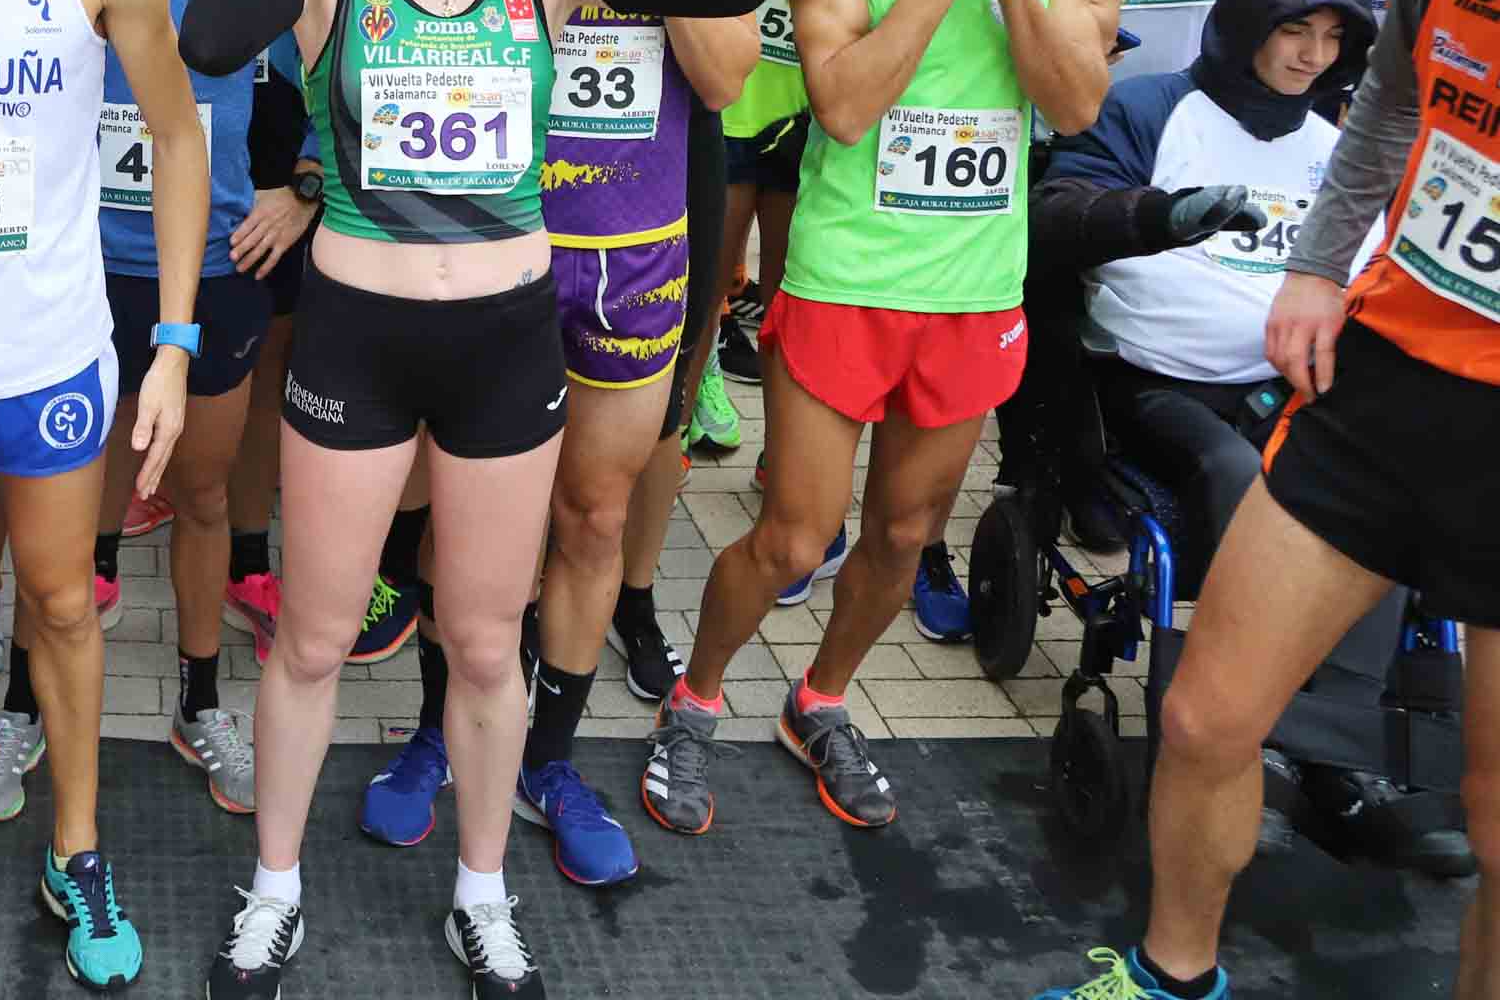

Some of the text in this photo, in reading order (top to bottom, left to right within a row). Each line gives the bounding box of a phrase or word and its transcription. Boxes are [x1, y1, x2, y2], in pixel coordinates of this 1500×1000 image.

[578, 32, 619, 45] Pedestre
[363, 45, 498, 66] VILLARREAL
[369, 72, 474, 87] VII Vuelta Pedestre
[568, 66, 635, 109] 33
[374, 89, 437, 101] a Salamanca
[889, 109, 900, 121] VII
[903, 112, 933, 124] Vuelta
[938, 113, 978, 126] Pedestre
[562, 120, 588, 129] RURAL
[591, 121, 603, 130] DE
[604, 122, 653, 130] SALAMANCA
[900, 124, 946, 135] Salamanca
[400, 111, 508, 161] 361
[116, 142, 154, 182] 4
[486, 162, 525, 170] LORENA
[915, 145, 1006, 187] 160
[388, 175, 412, 184] CAJA
[414, 177, 445, 186] RURAL
[114, 192, 138, 200] RURAL
[898, 199, 919, 207] CAJA
[921, 200, 947, 208] RURAL
[962, 199, 1009, 208] SALAMANCA
[291, 380, 346, 413] GENERALITAT
